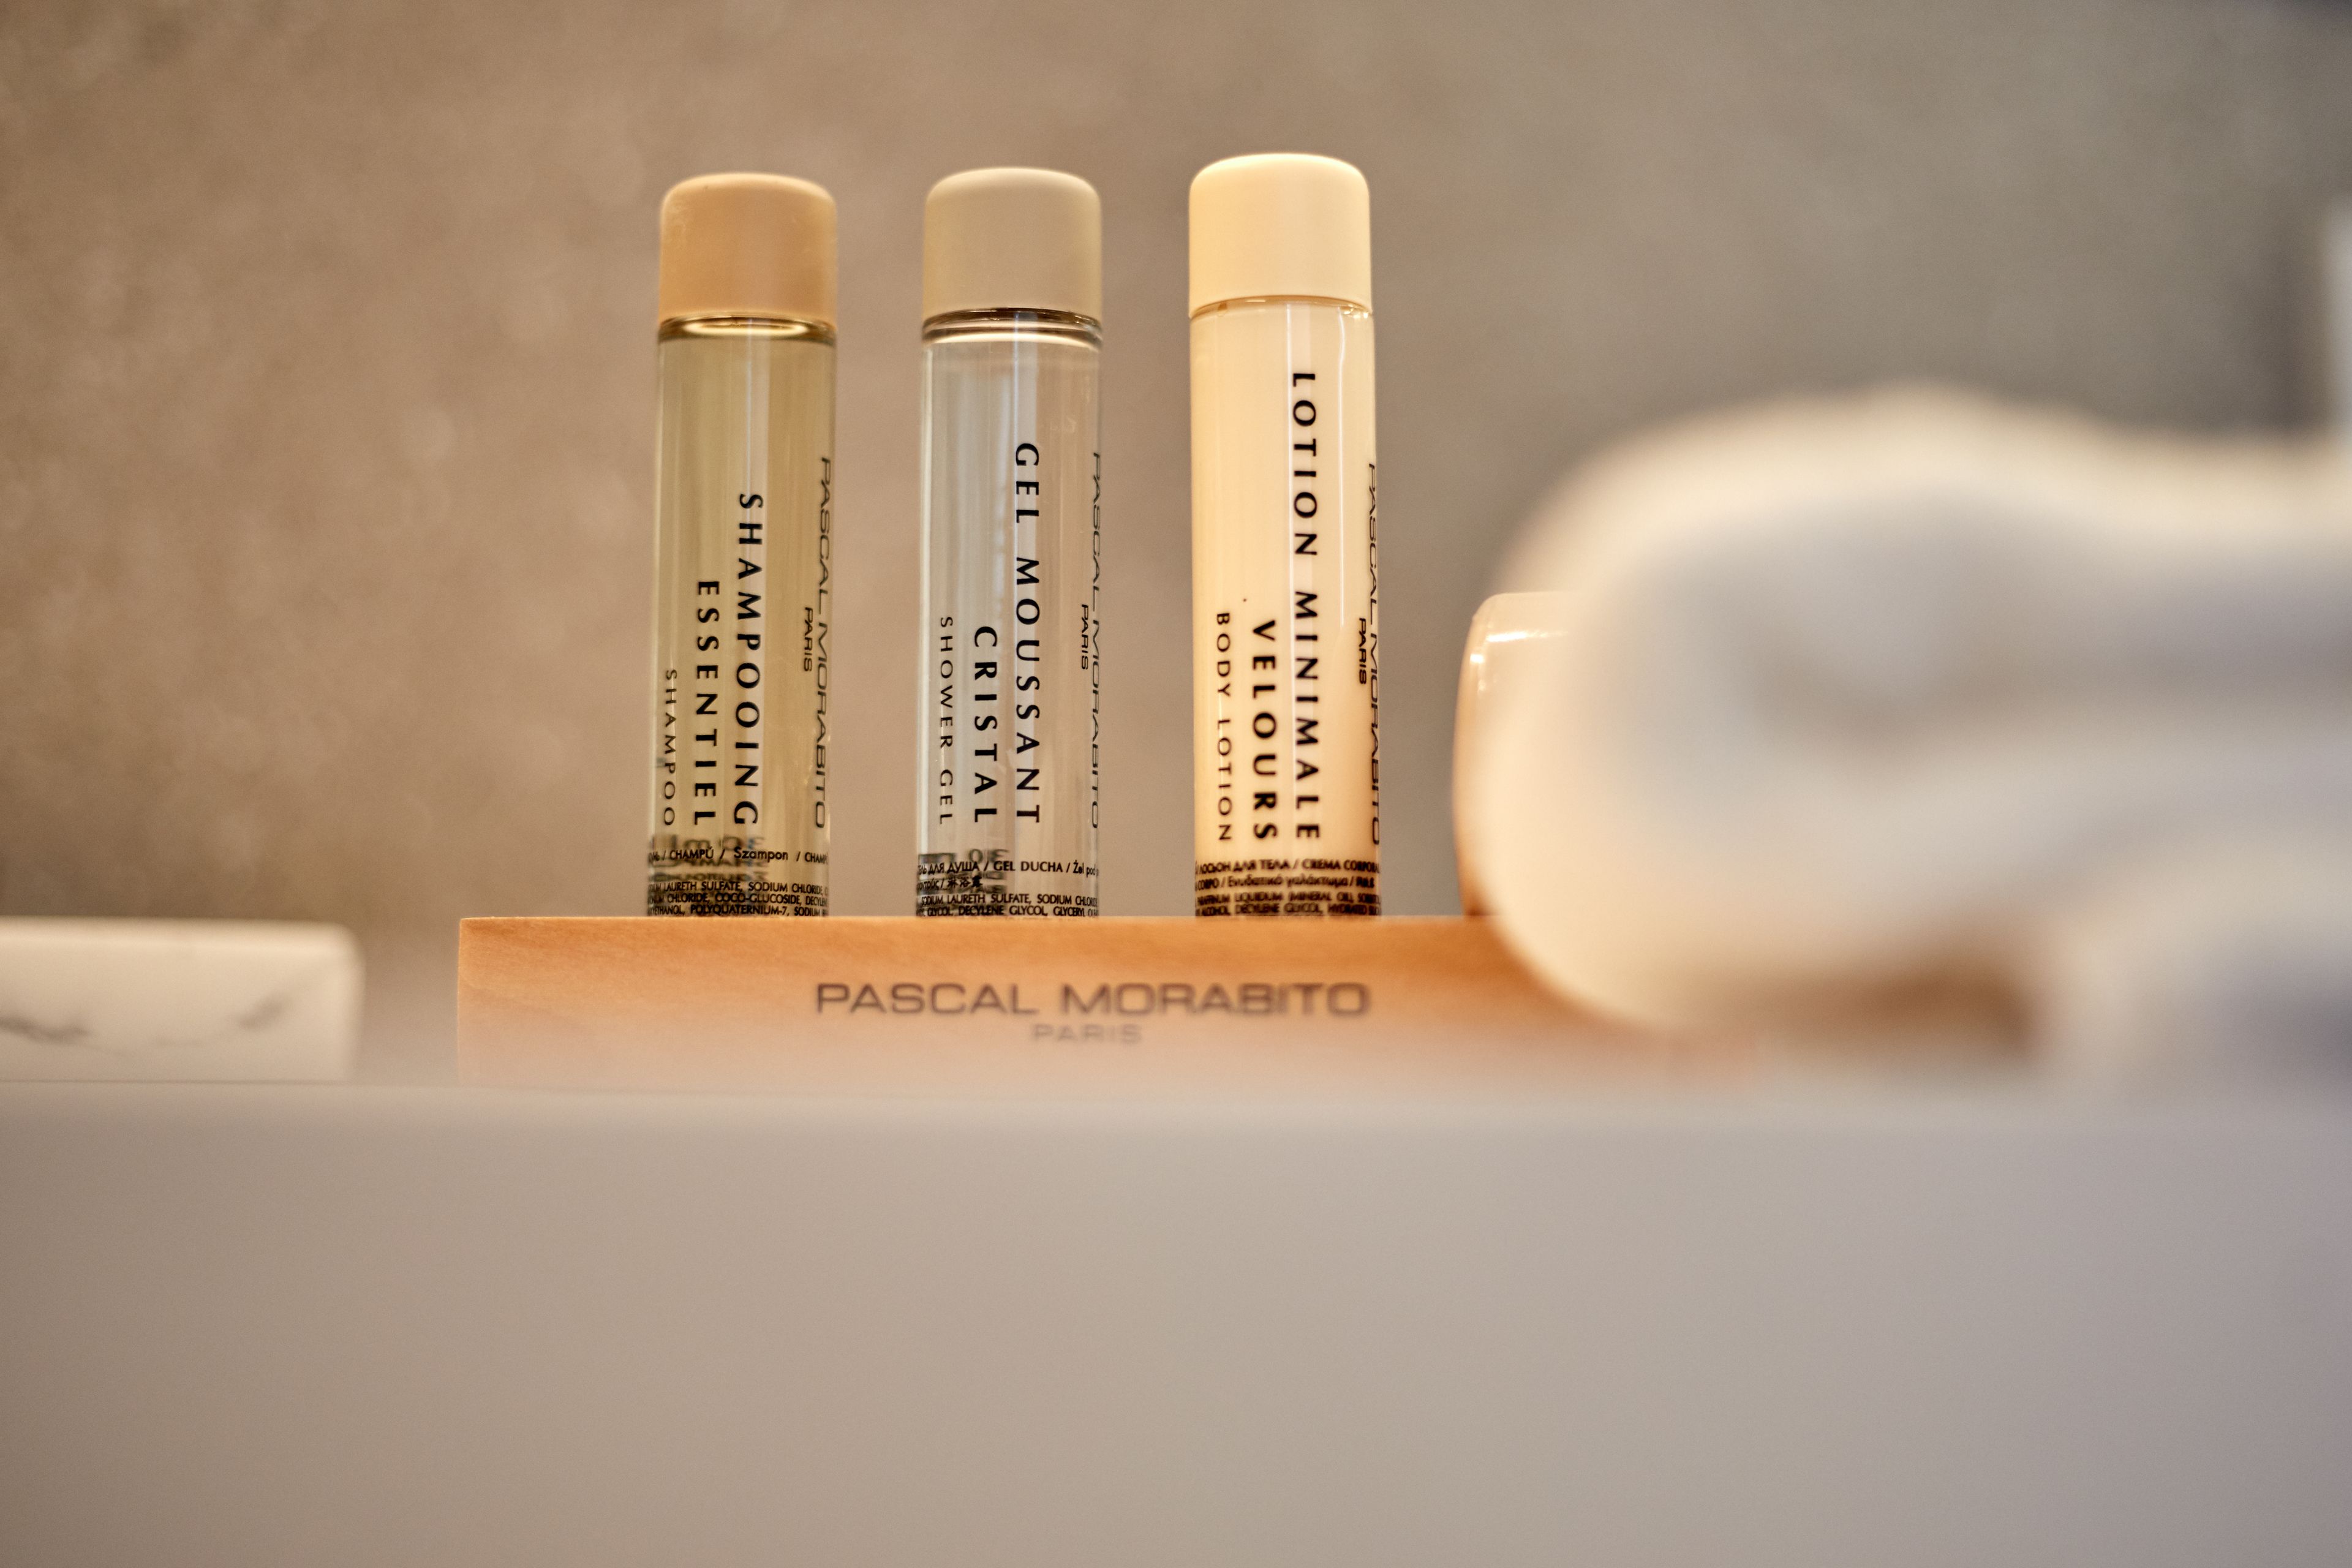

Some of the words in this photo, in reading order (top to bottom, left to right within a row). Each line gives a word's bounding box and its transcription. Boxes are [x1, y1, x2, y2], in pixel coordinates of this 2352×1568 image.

[1015, 442, 1040, 524] GEL
[1292, 372, 1318, 556] LOTION
[818, 456, 831, 615] PASCAL
[1092, 452, 1101, 612] PASCAL
[1368, 462, 1377, 625] PASCAL
[694, 581, 720, 825] ESSENTIEL
[734, 493, 764, 825] SHAMPOOING
[803, 606, 813, 673] PARIS
[940, 616, 954, 749] SHOWER
[1016, 556, 1041, 823] MOUSSANT
[1216, 612, 1232, 697] BODY
[1358, 617, 1366, 685] PARIS
[663, 669, 678, 826] SHAMPOO
[815, 622, 828, 829] MORABITO
[974, 626, 998, 823] CRISTAL
[1091, 619, 1101, 829] MORABITO
[1252, 620, 1278, 839] VELOURS
[1295, 591, 1320, 839] MINIMALE
[940, 769, 954, 825] GEL
[1216, 720, 1233, 841] LOTION
[664, 881, 697, 892] LAURETH
[701, 881, 743, 892] SULFATE,
[748, 881, 788, 892] SODIUM
[792, 883, 824, 896] CHLORIDE,
[667, 893, 710, 904] CHLORIDE,
[715, 892, 802, 906] COCO-GLUCOSIDE,
[669, 846, 714, 860] CHAMPÚ
[734, 846, 788, 862] Szampon
[947, 894, 986, 904] LAURETH
[991, 894, 1031, 905] SULFATE,
[1037, 894, 1072, 905] SODIUM
[993, 861, 1016, 871] GEL
[1020, 861, 1063, 872] DUCHA
[1302, 859, 1341, 870] CREMA
[816, 982, 1039, 1014] PASCAL
[1061, 982, 1371, 1016] MORABITO
[1032, 1023, 1143, 1045] PARIS
